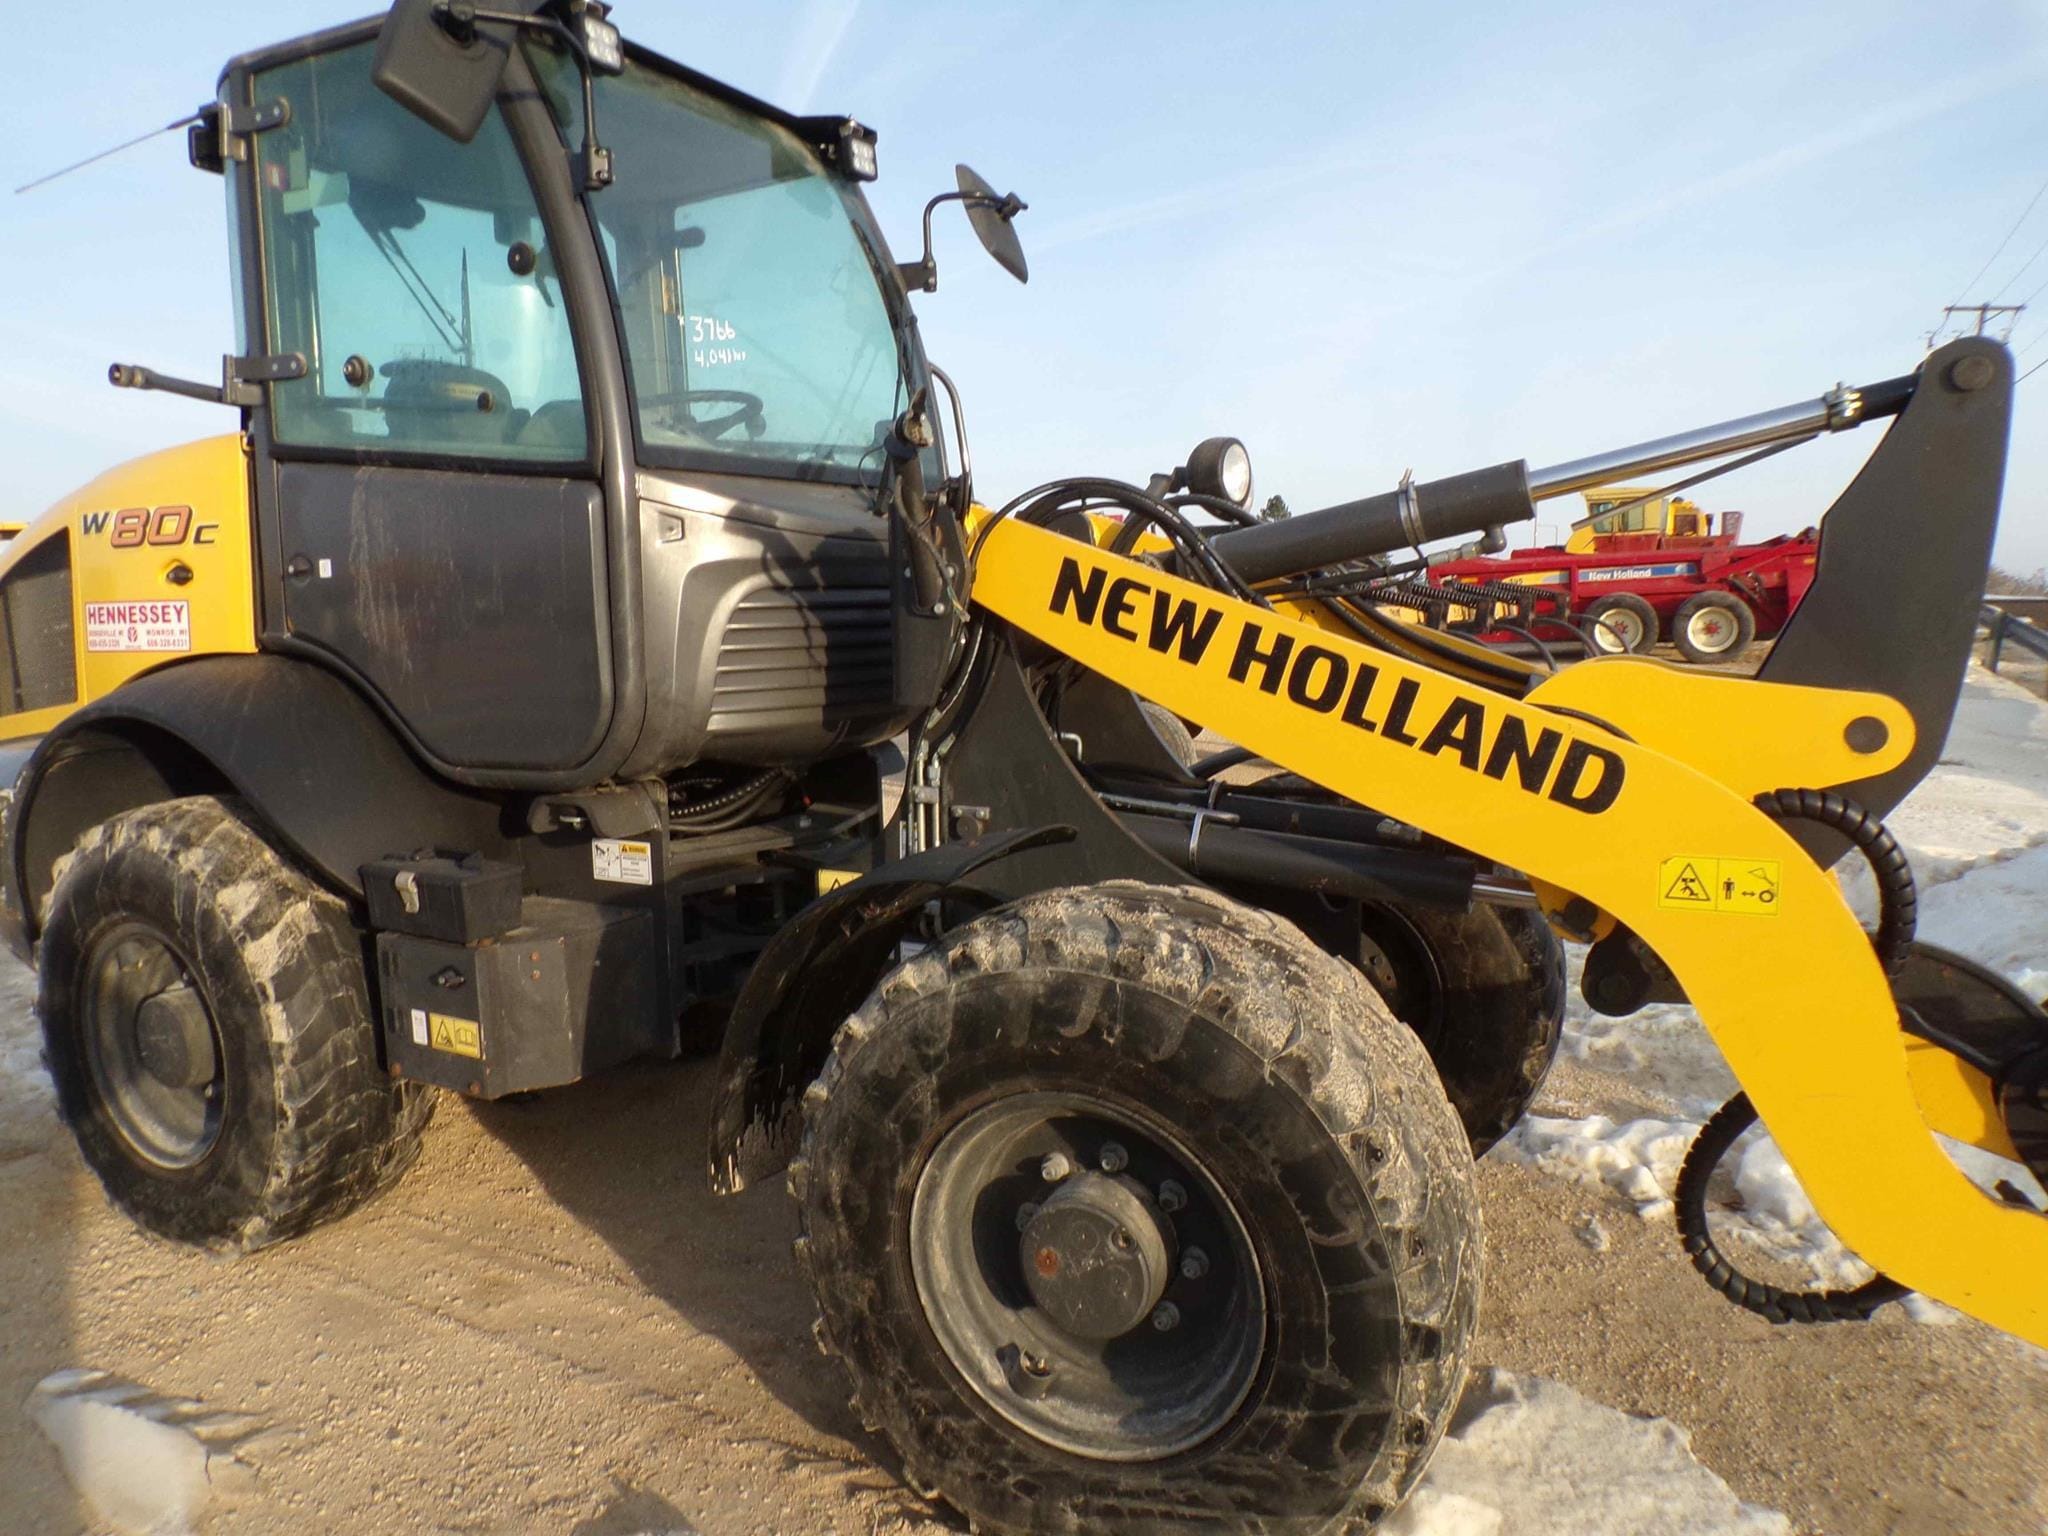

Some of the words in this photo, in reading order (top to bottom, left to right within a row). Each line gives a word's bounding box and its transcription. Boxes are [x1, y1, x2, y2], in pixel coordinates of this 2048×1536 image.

[689, 315, 736, 342] 3766
[1588, 572, 1611, 582] New
[1612, 568, 1652, 580] Holland
[88, 604, 184, 625] HENNESSEY
[1049, 556, 1223, 665] NEW
[1228, 621, 1626, 814] HOLLAND
